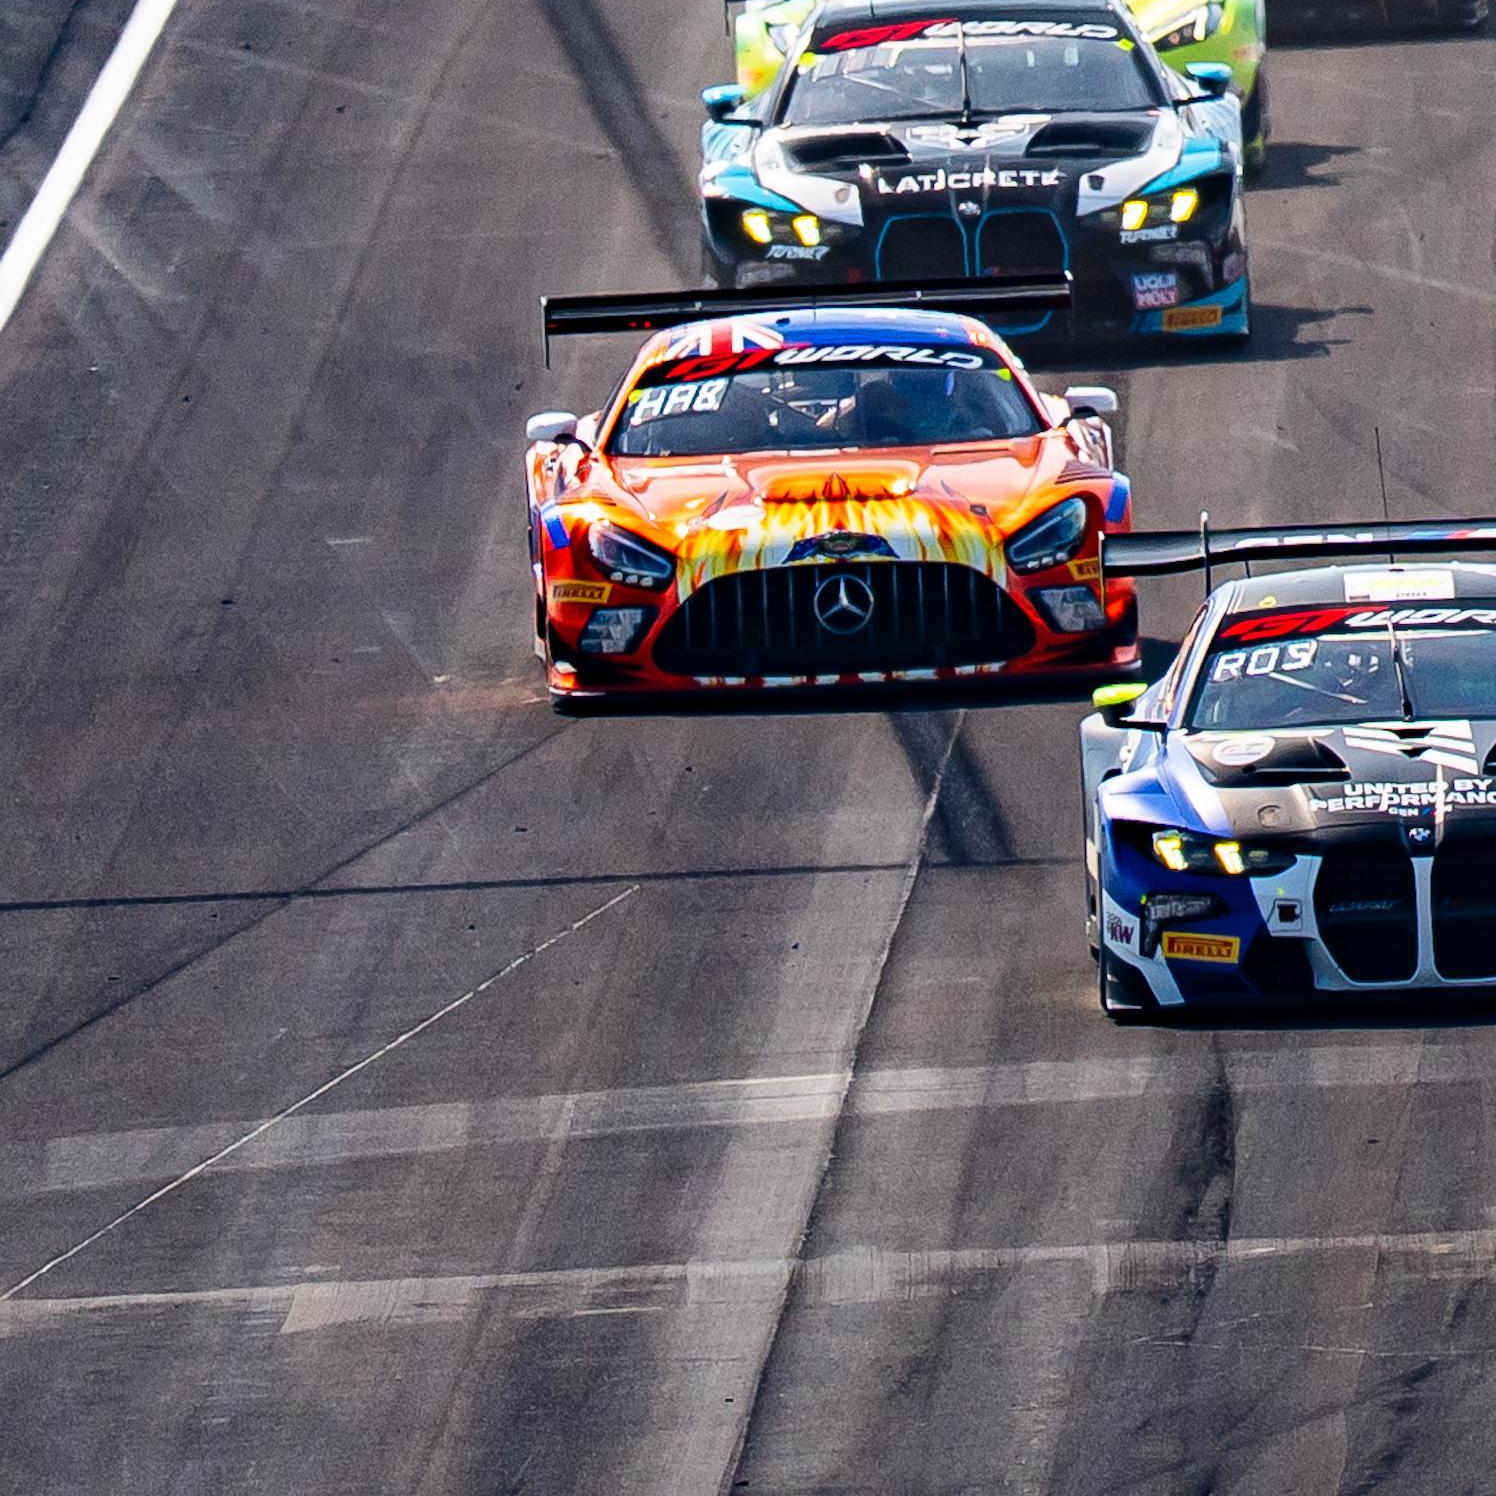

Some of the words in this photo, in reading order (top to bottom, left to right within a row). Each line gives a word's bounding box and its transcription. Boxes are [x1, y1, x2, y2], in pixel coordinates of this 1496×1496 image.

[773, 344, 984, 370] WORLD
[1344, 780, 1449, 798] UNITED
[1454, 778, 1493, 792] BY
[1387, 806, 1419, 817] GEN
[1167, 935, 1234, 958] PIRELLI
